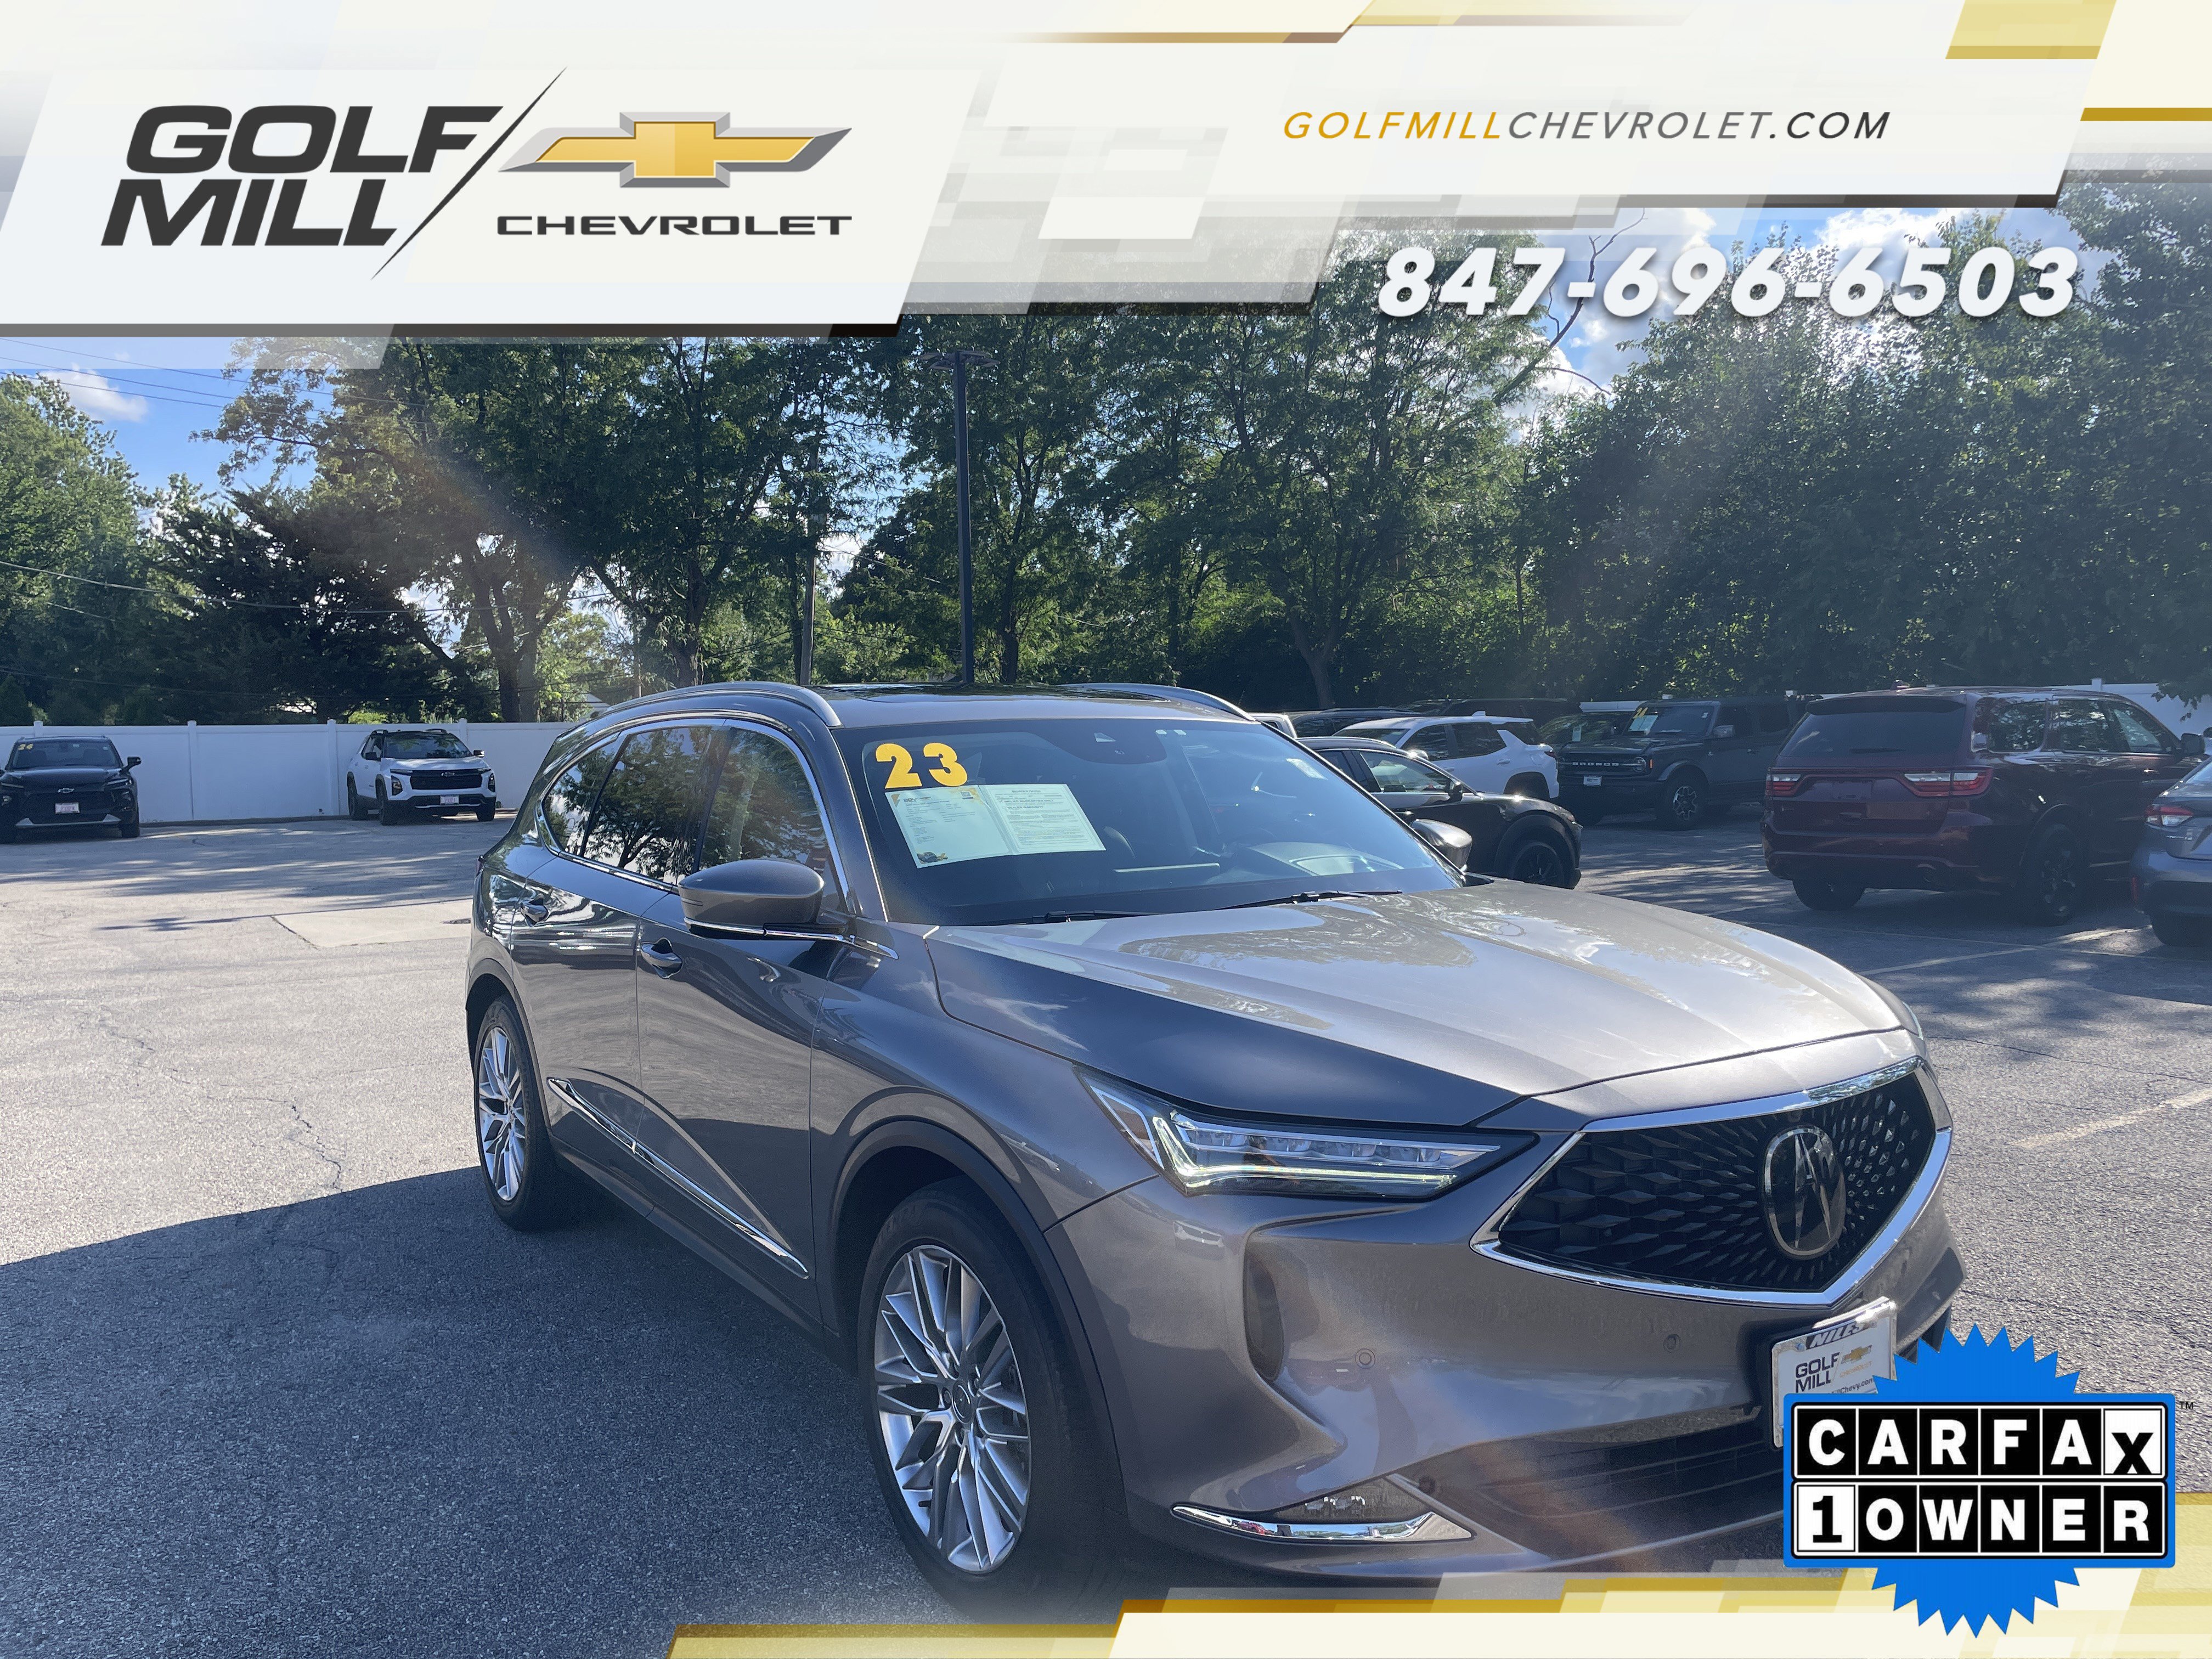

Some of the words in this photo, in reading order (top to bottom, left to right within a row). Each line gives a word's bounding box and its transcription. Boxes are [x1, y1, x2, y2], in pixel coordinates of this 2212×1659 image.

[876, 743, 967, 788] 23
[1809, 1322, 1864, 1348] NILES
[1795, 1351, 1840, 1379] GOLF
[1795, 1370, 1832, 1393] MILL
